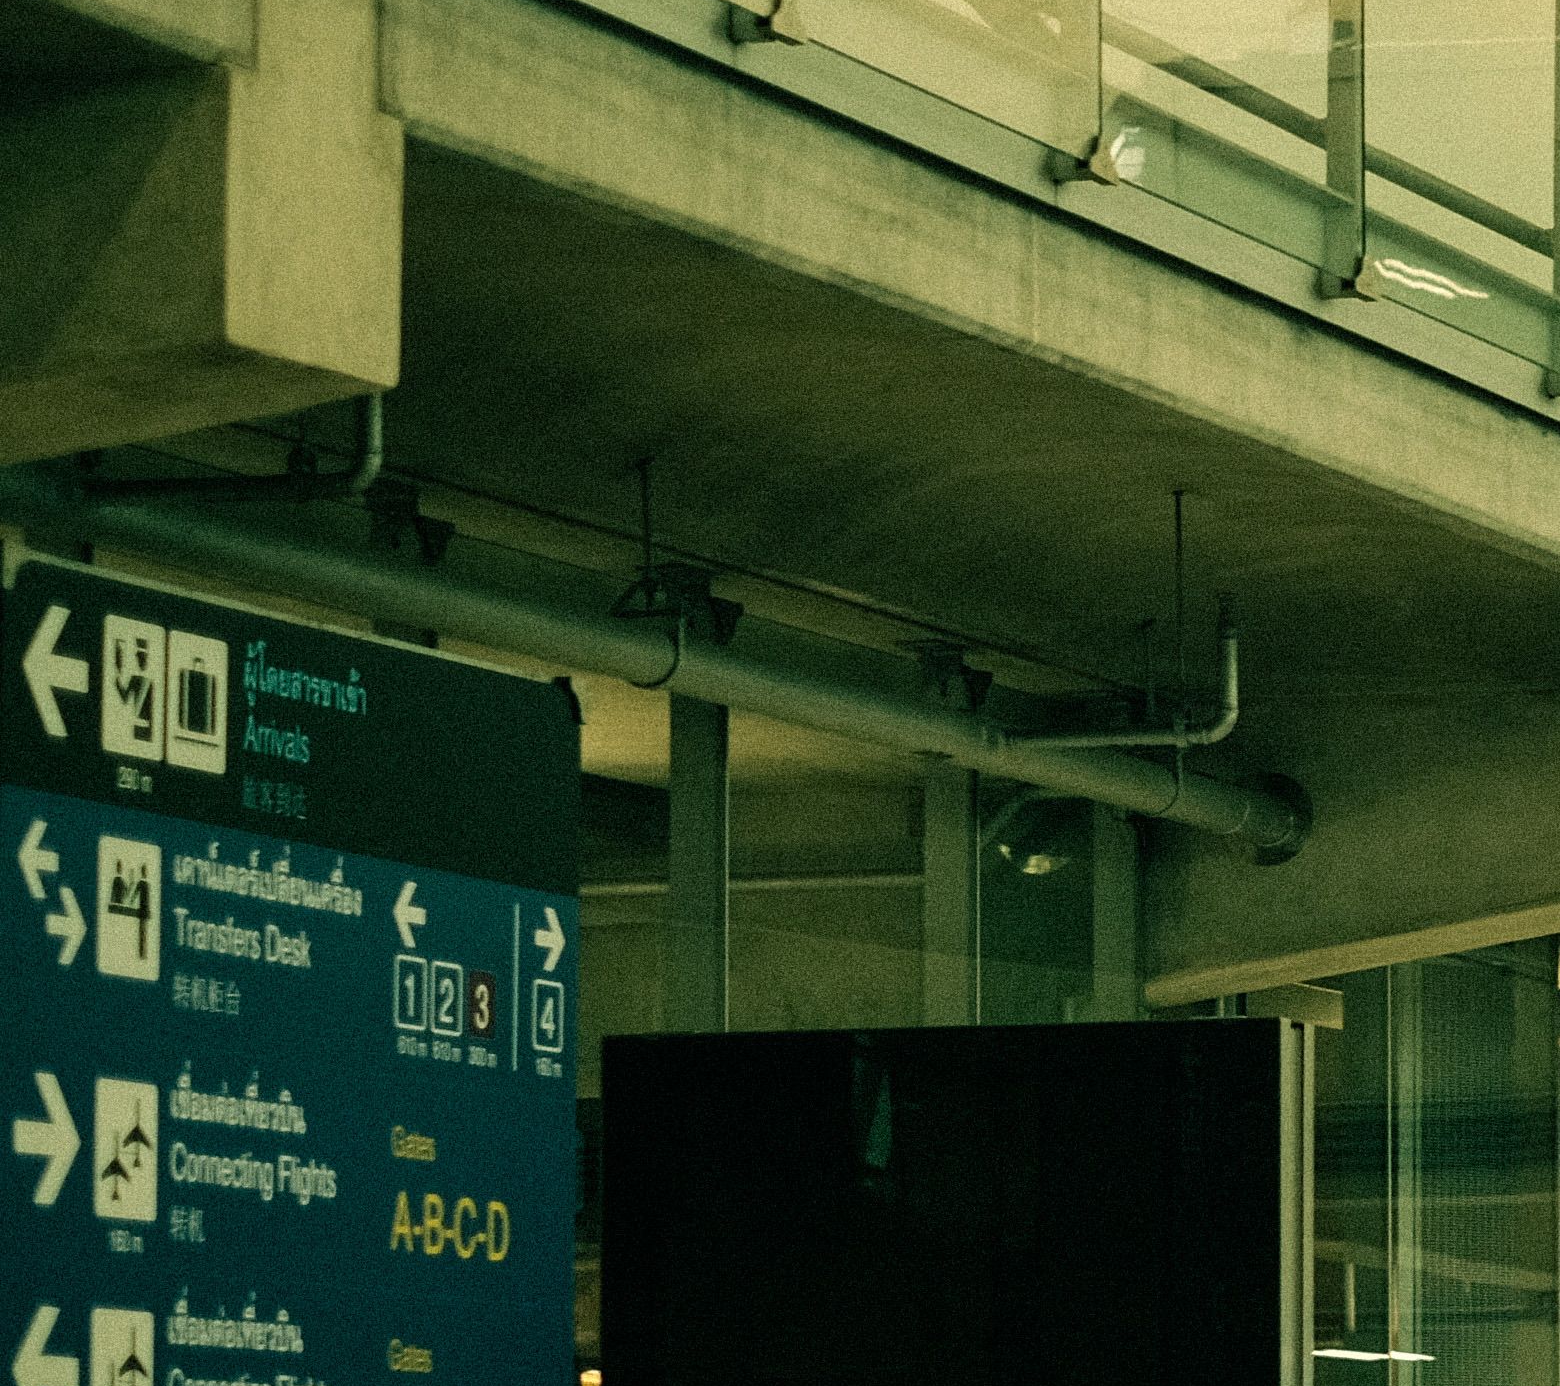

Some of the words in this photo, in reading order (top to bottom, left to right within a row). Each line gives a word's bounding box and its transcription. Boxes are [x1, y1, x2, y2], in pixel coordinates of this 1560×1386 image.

[243, 715, 310, 764] Arrivals
[173, 907, 261, 960] Transfers
[264, 924, 311, 968] Desk
[404, 974, 415, 1017] 1
[440, 978, 454, 1023] 2
[475, 984, 489, 1029] 3
[540, 997, 555, 1039] 4
[170, 1142, 273, 1201] Connecting
[278, 1155, 337, 1205] Flights
[390, 1191, 510, 1261] A-B-C-D
